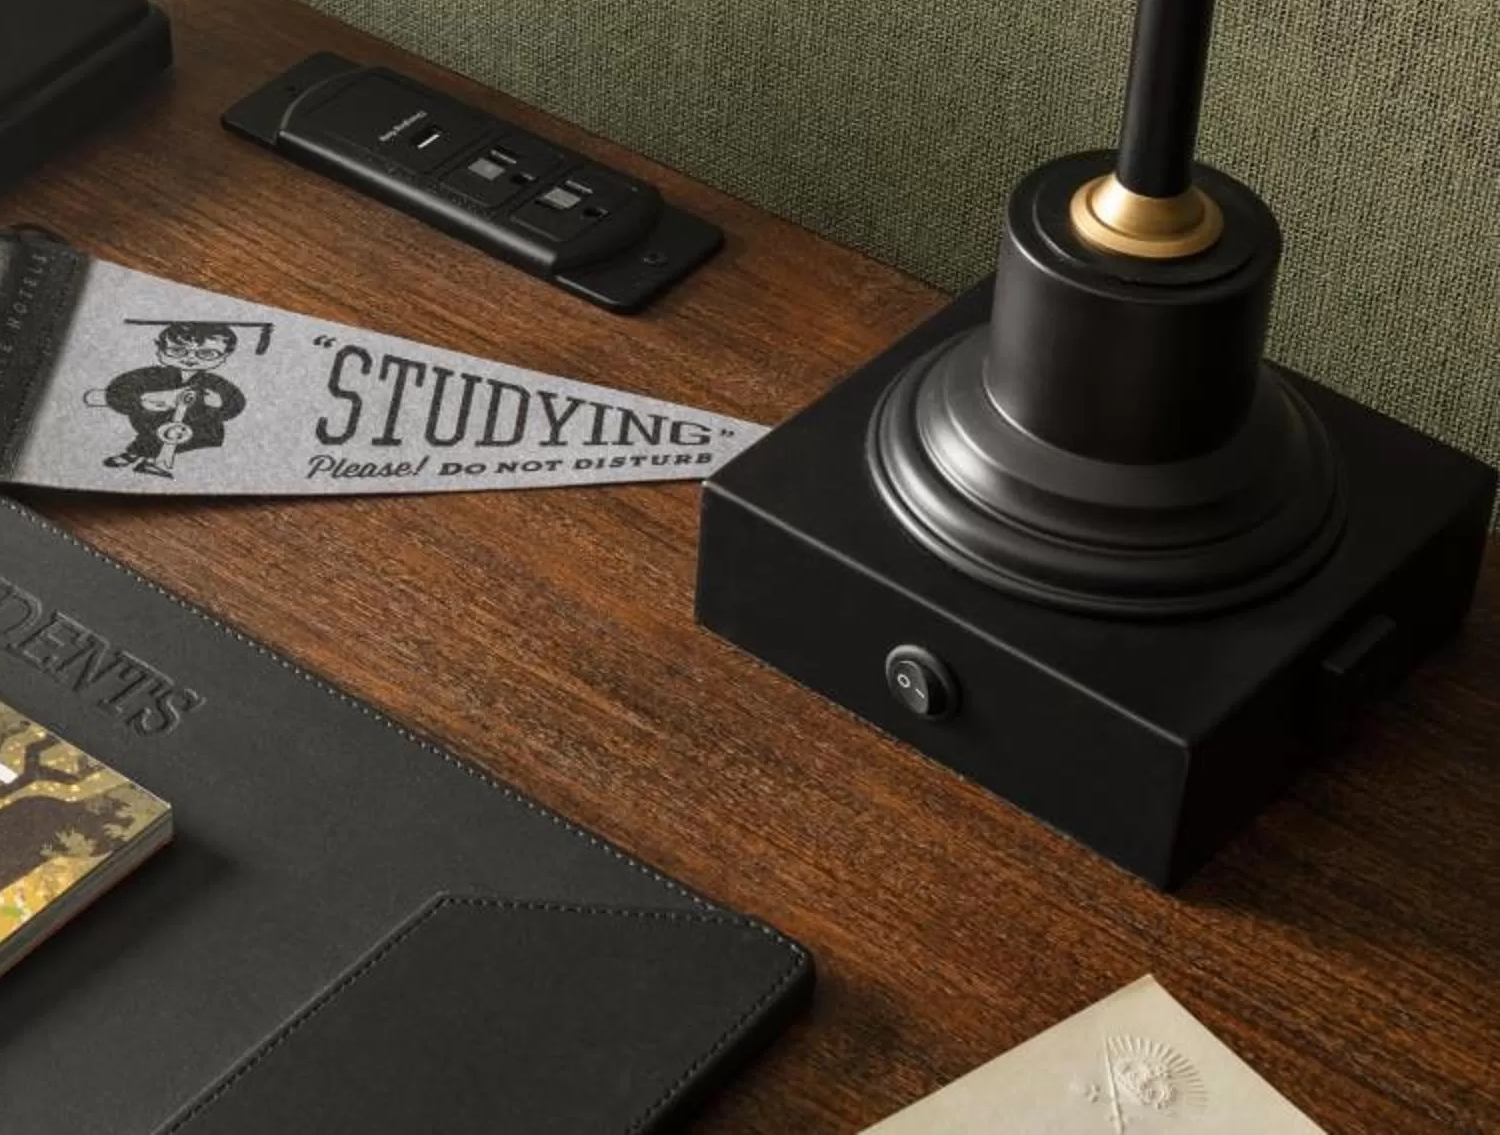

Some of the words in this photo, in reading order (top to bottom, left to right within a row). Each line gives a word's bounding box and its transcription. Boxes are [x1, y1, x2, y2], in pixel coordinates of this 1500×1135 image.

[305, 454, 430, 480] Please!
[439, 461, 486, 477] DO
[496, 459, 565, 475] NOT
[574, 452, 714, 471] DISTURB
